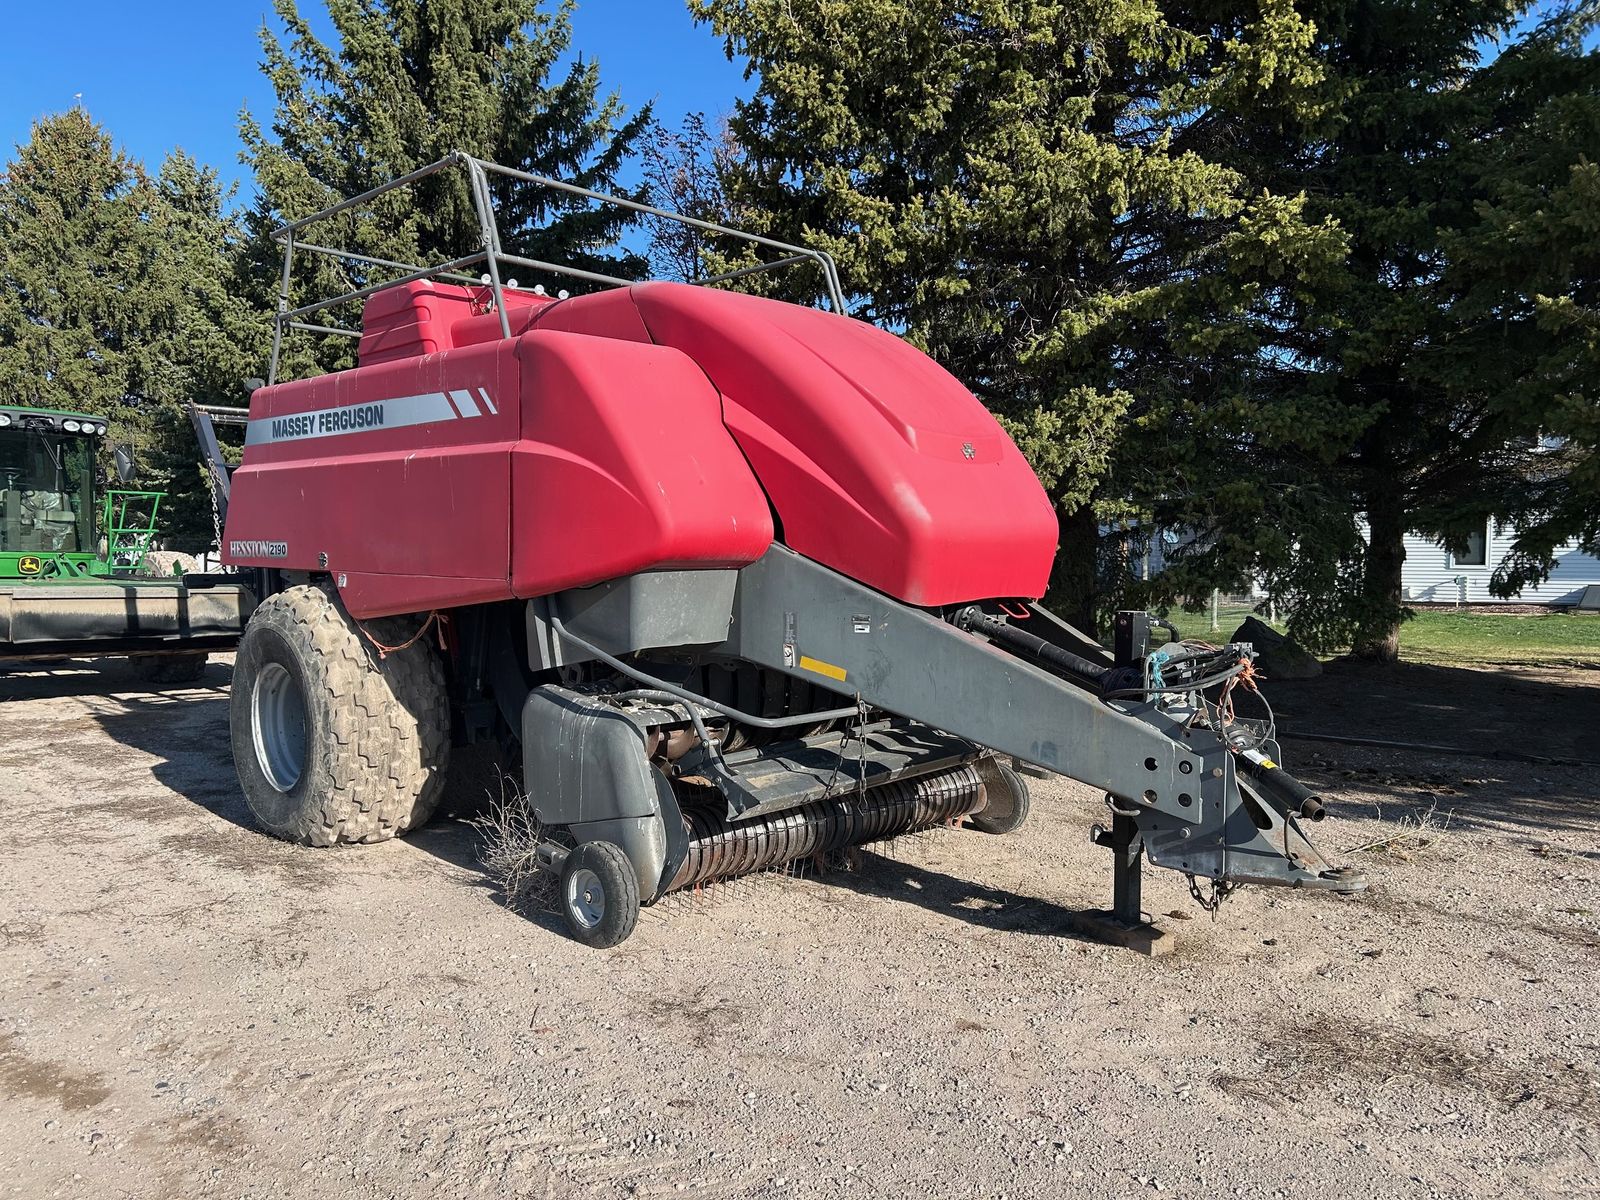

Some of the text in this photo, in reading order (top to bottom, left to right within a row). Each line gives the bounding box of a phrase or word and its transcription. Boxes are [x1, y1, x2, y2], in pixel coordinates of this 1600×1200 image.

[272, 404, 384, 438] MASSEY FERGUSON
[230, 540, 287, 558] HESSTON 2190
